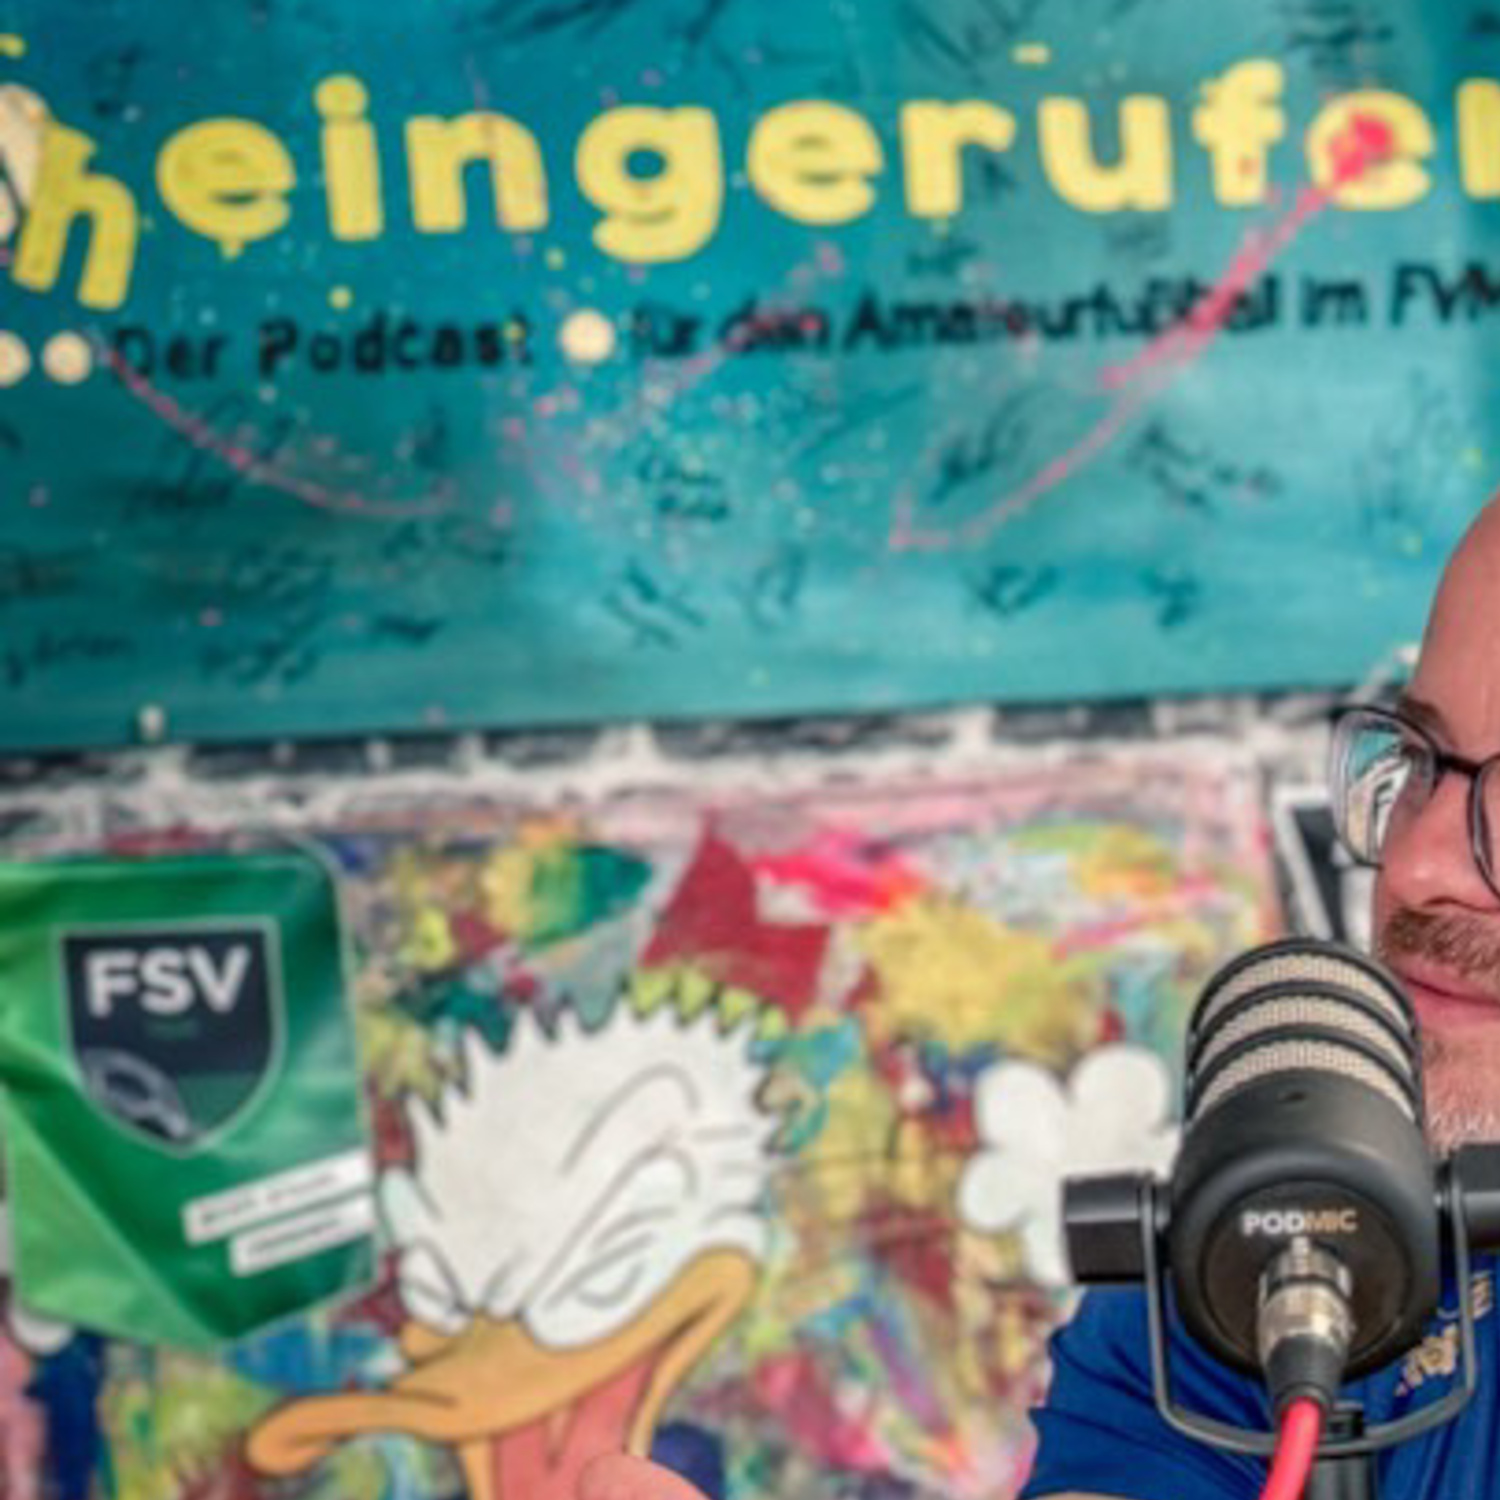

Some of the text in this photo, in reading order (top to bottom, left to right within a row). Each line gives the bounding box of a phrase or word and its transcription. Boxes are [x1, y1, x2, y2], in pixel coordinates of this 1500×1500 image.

[257, 303, 534, 379] Podcast
[84, 945, 251, 1017] FSV
[1242, 1208, 1359, 1237] PODMIC
